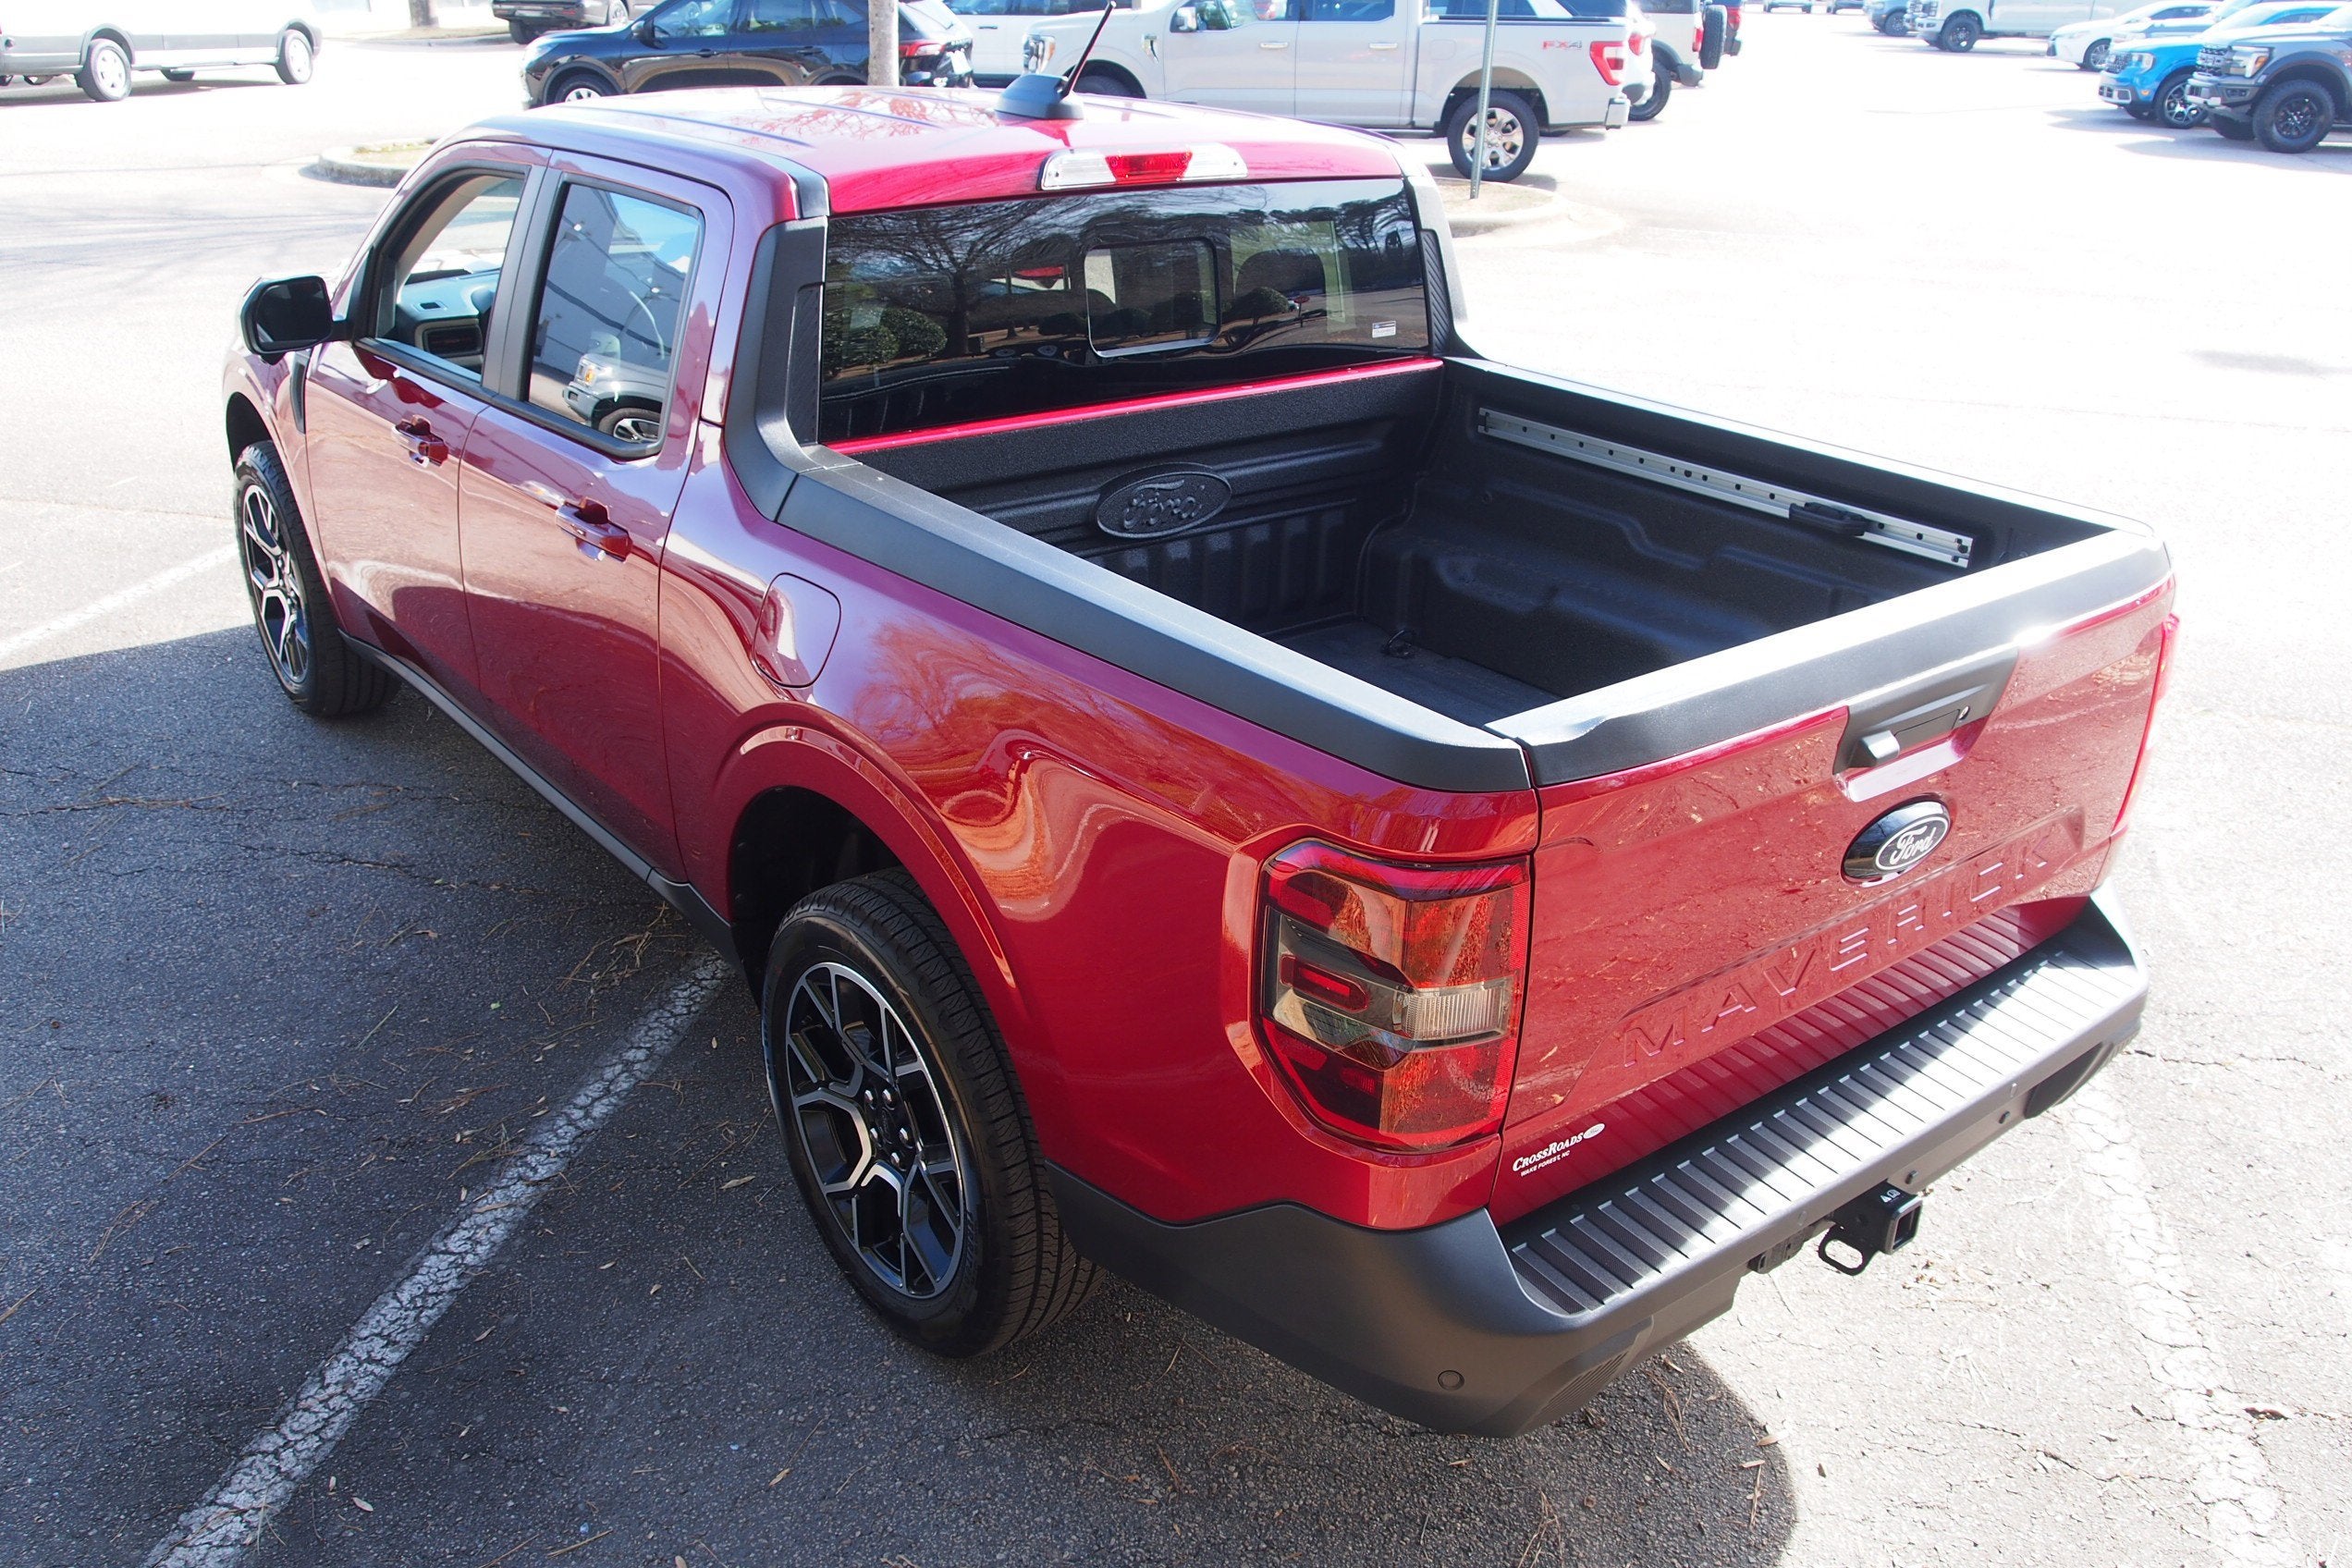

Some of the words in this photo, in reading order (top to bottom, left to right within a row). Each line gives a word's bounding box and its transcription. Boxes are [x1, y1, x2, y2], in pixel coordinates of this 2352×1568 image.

[1889, 825, 1937, 865] Ford
[1623, 833, 2050, 1068] MAVERICK
[1520, 1164, 1537, 1177] WAKE
[1561, 1150, 1571, 1158] NC
